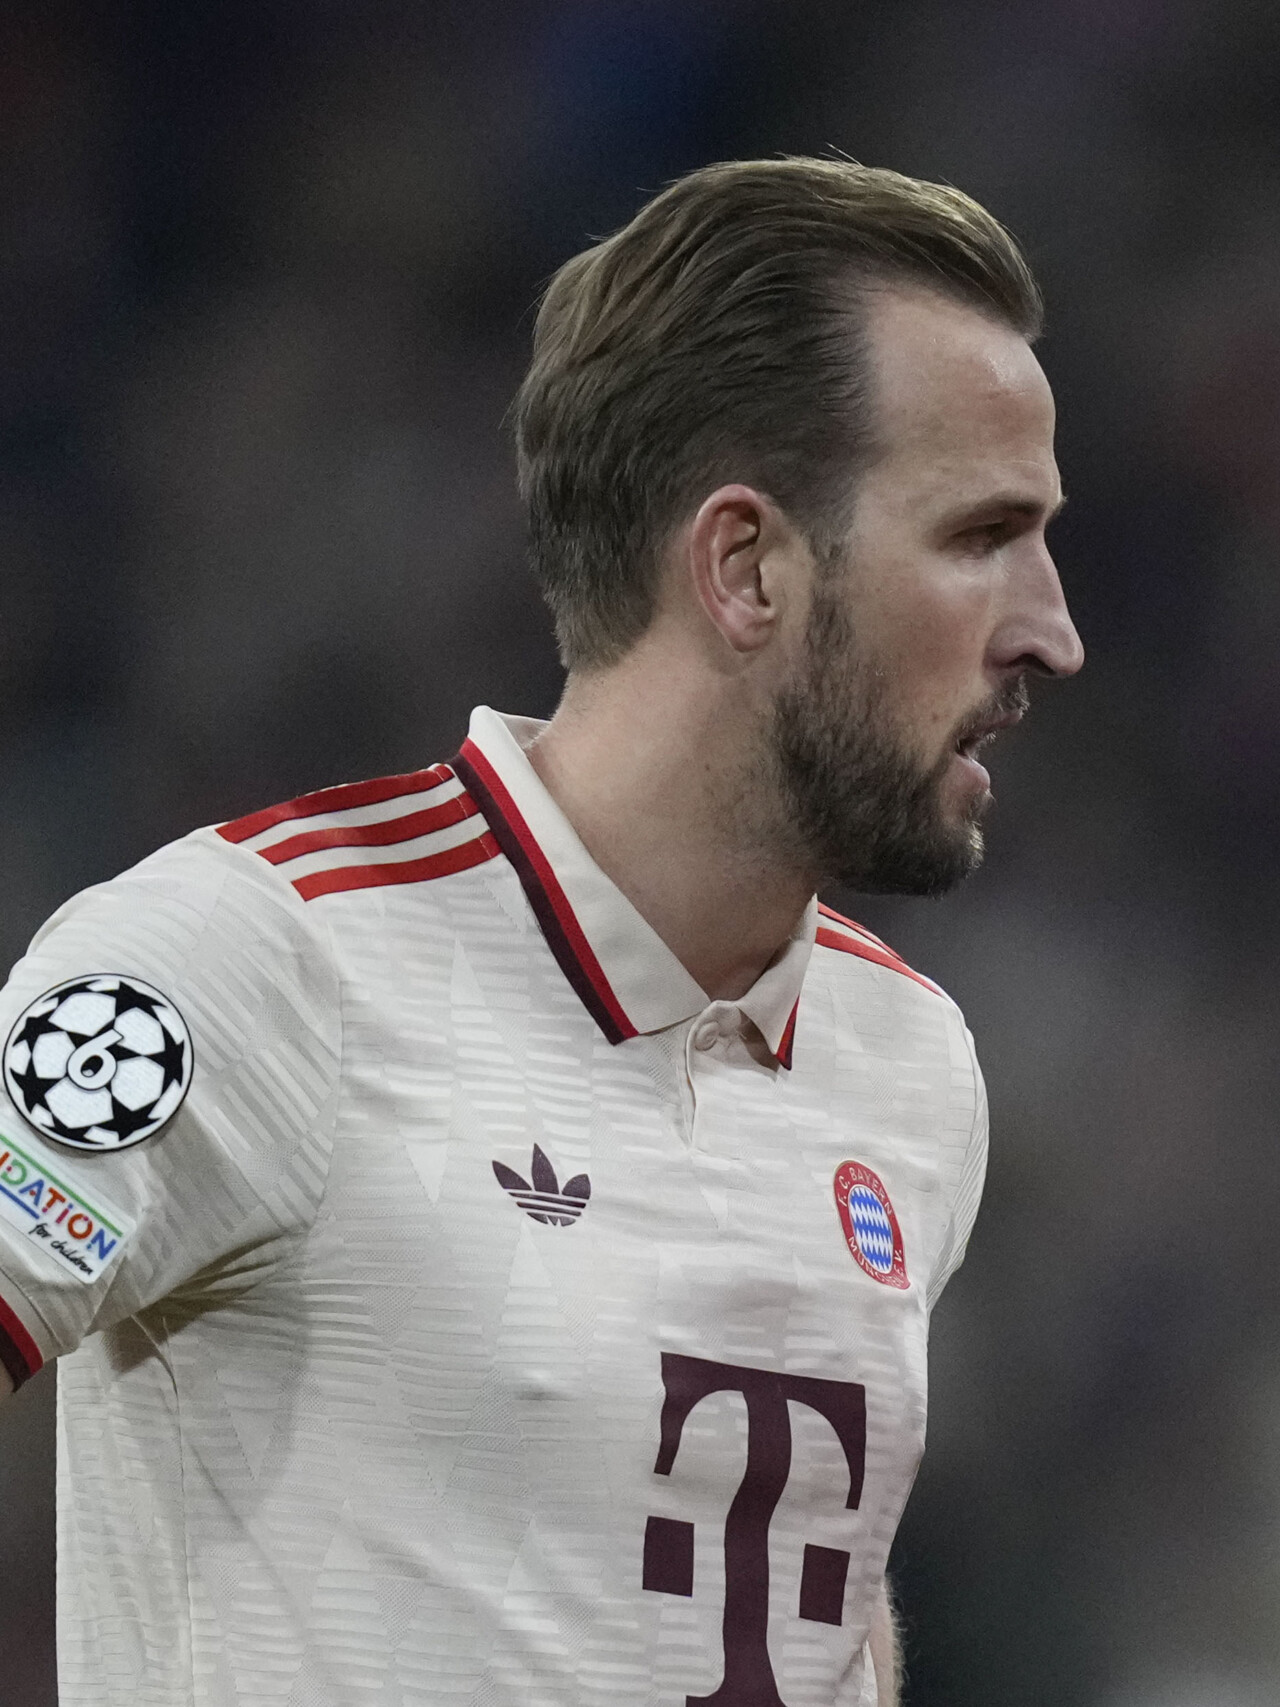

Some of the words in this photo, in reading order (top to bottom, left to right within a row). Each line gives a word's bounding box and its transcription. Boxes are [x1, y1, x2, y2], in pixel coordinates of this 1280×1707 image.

[848, 1167, 893, 1216] BAYERN
[28, 1222, 52, 1239] for
[50, 1240, 94, 1276] children
